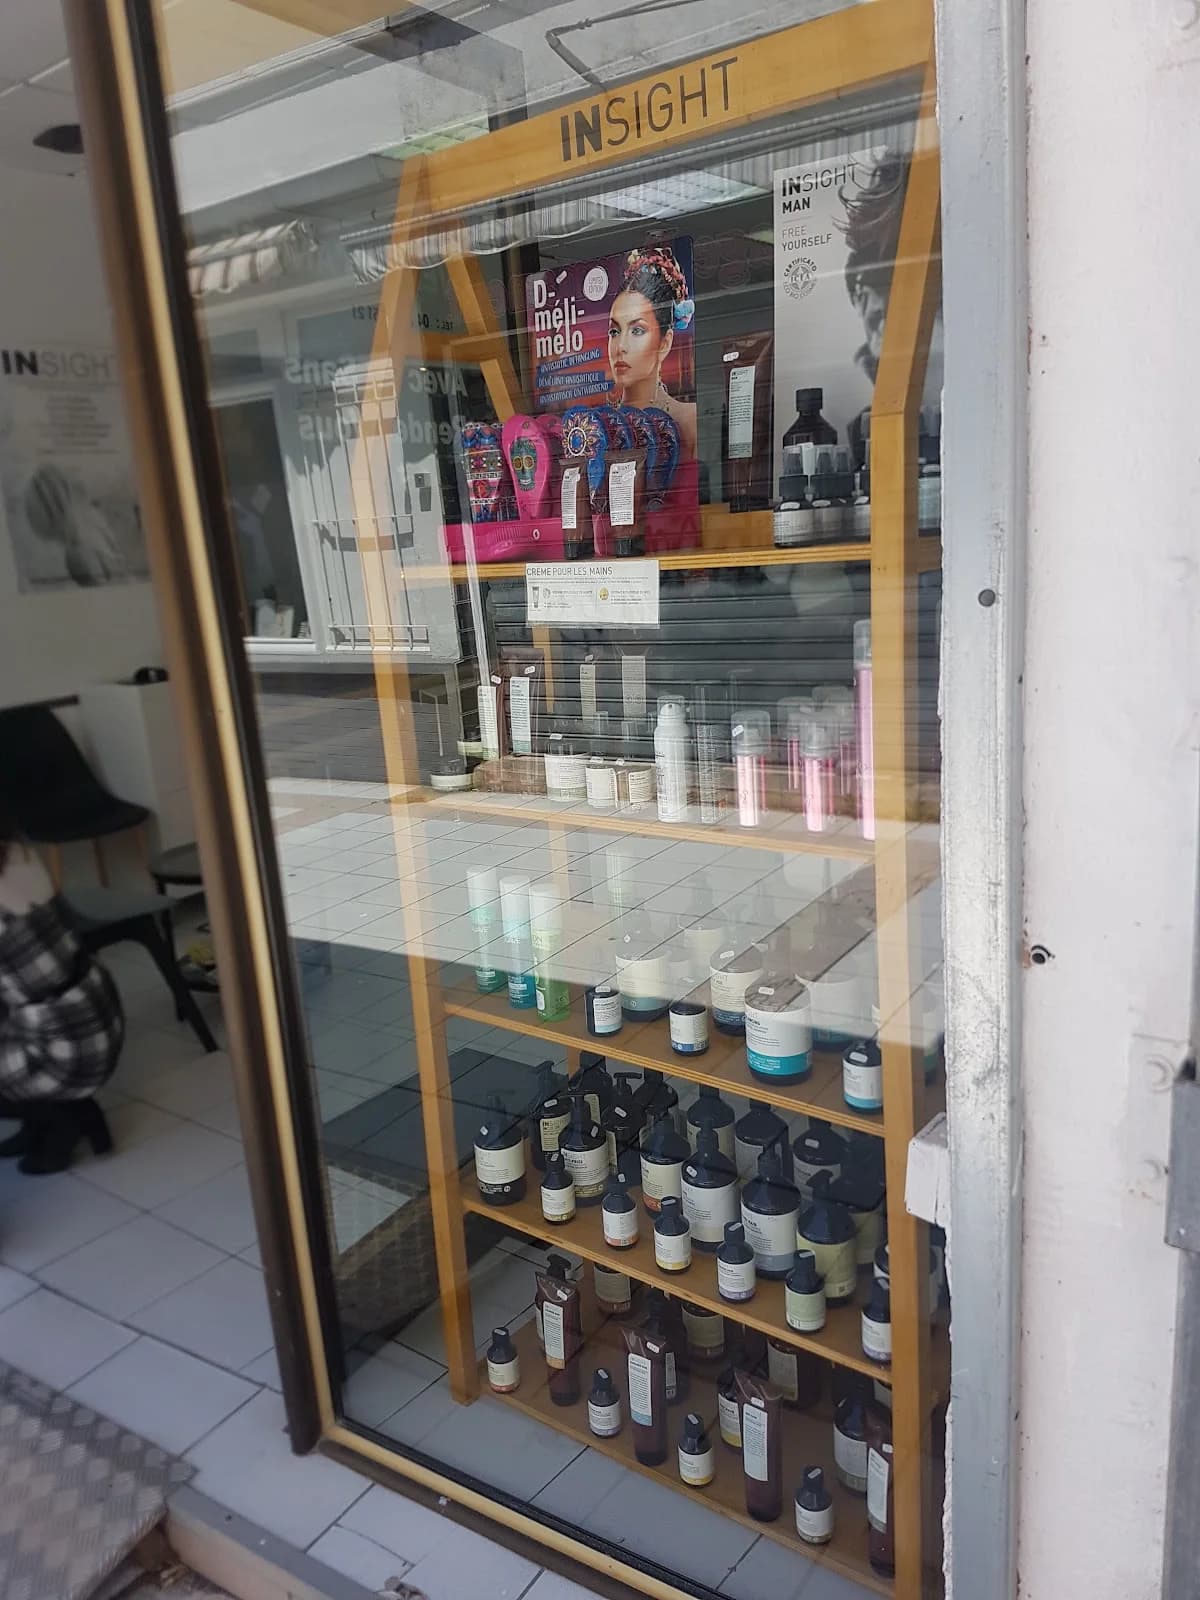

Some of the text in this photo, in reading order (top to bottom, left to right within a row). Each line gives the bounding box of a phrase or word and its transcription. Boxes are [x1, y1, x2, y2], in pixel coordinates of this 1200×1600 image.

[560, 57, 738, 162] INSIGHT
[782, 162, 860, 197] INSIGHT
[782, 197, 810, 214] MAN
[782, 225, 807, 239] FREE
[782, 233, 833, 251] YOURSELF
[534, 297, 585, 333] méli-
[536, 324, 584, 359] mélo
[1, 350, 116, 378] INSIGH
[526, 566, 613, 577] CREME POUR LES MAINS
